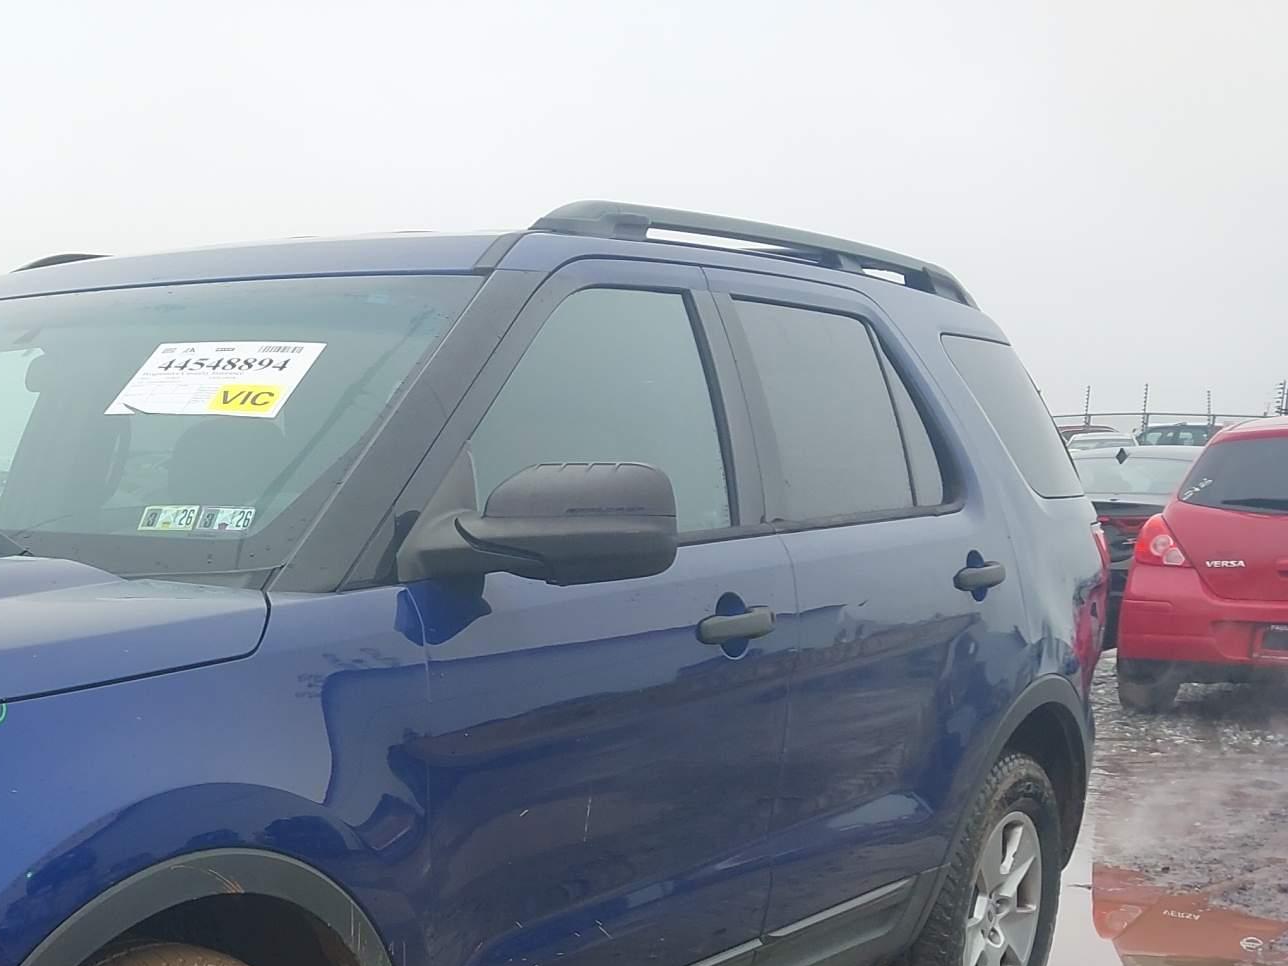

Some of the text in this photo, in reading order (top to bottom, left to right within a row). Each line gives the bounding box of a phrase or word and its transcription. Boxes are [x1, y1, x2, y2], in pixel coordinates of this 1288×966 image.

[158, 357, 291, 372] 44548894
[220, 390, 275, 406] VIC
[178, 508, 195, 526] 26
[235, 510, 253, 528] 26
[1205, 560, 1246, 568] VERSA
